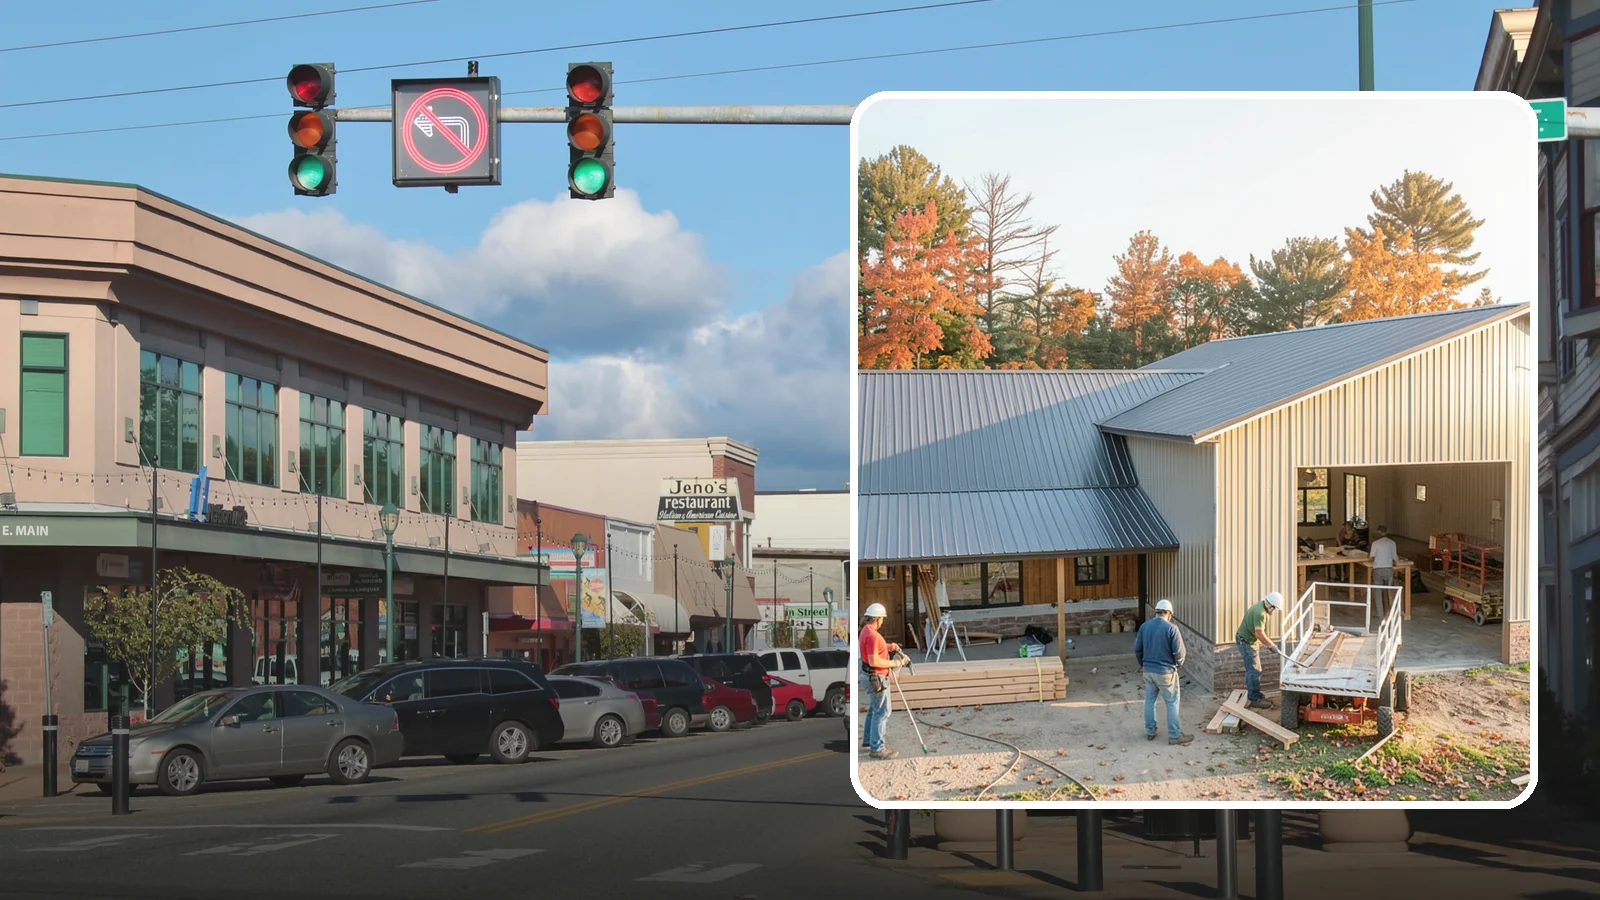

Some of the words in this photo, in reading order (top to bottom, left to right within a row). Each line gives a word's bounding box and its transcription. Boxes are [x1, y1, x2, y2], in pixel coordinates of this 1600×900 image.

[670, 480, 727, 495] Jeno's
[665, 496, 731, 509] restaurant
[659, 510, 681, 519] Italian
[686, 510, 714, 519] American
[715, 509, 738, 519] Cuisine
[2, 525, 13, 536] E.
[15, 525, 49, 536] MAIN
[785, 607, 795, 617] in
[797, 607, 828, 617] Street
[790, 619, 824, 627] lass
